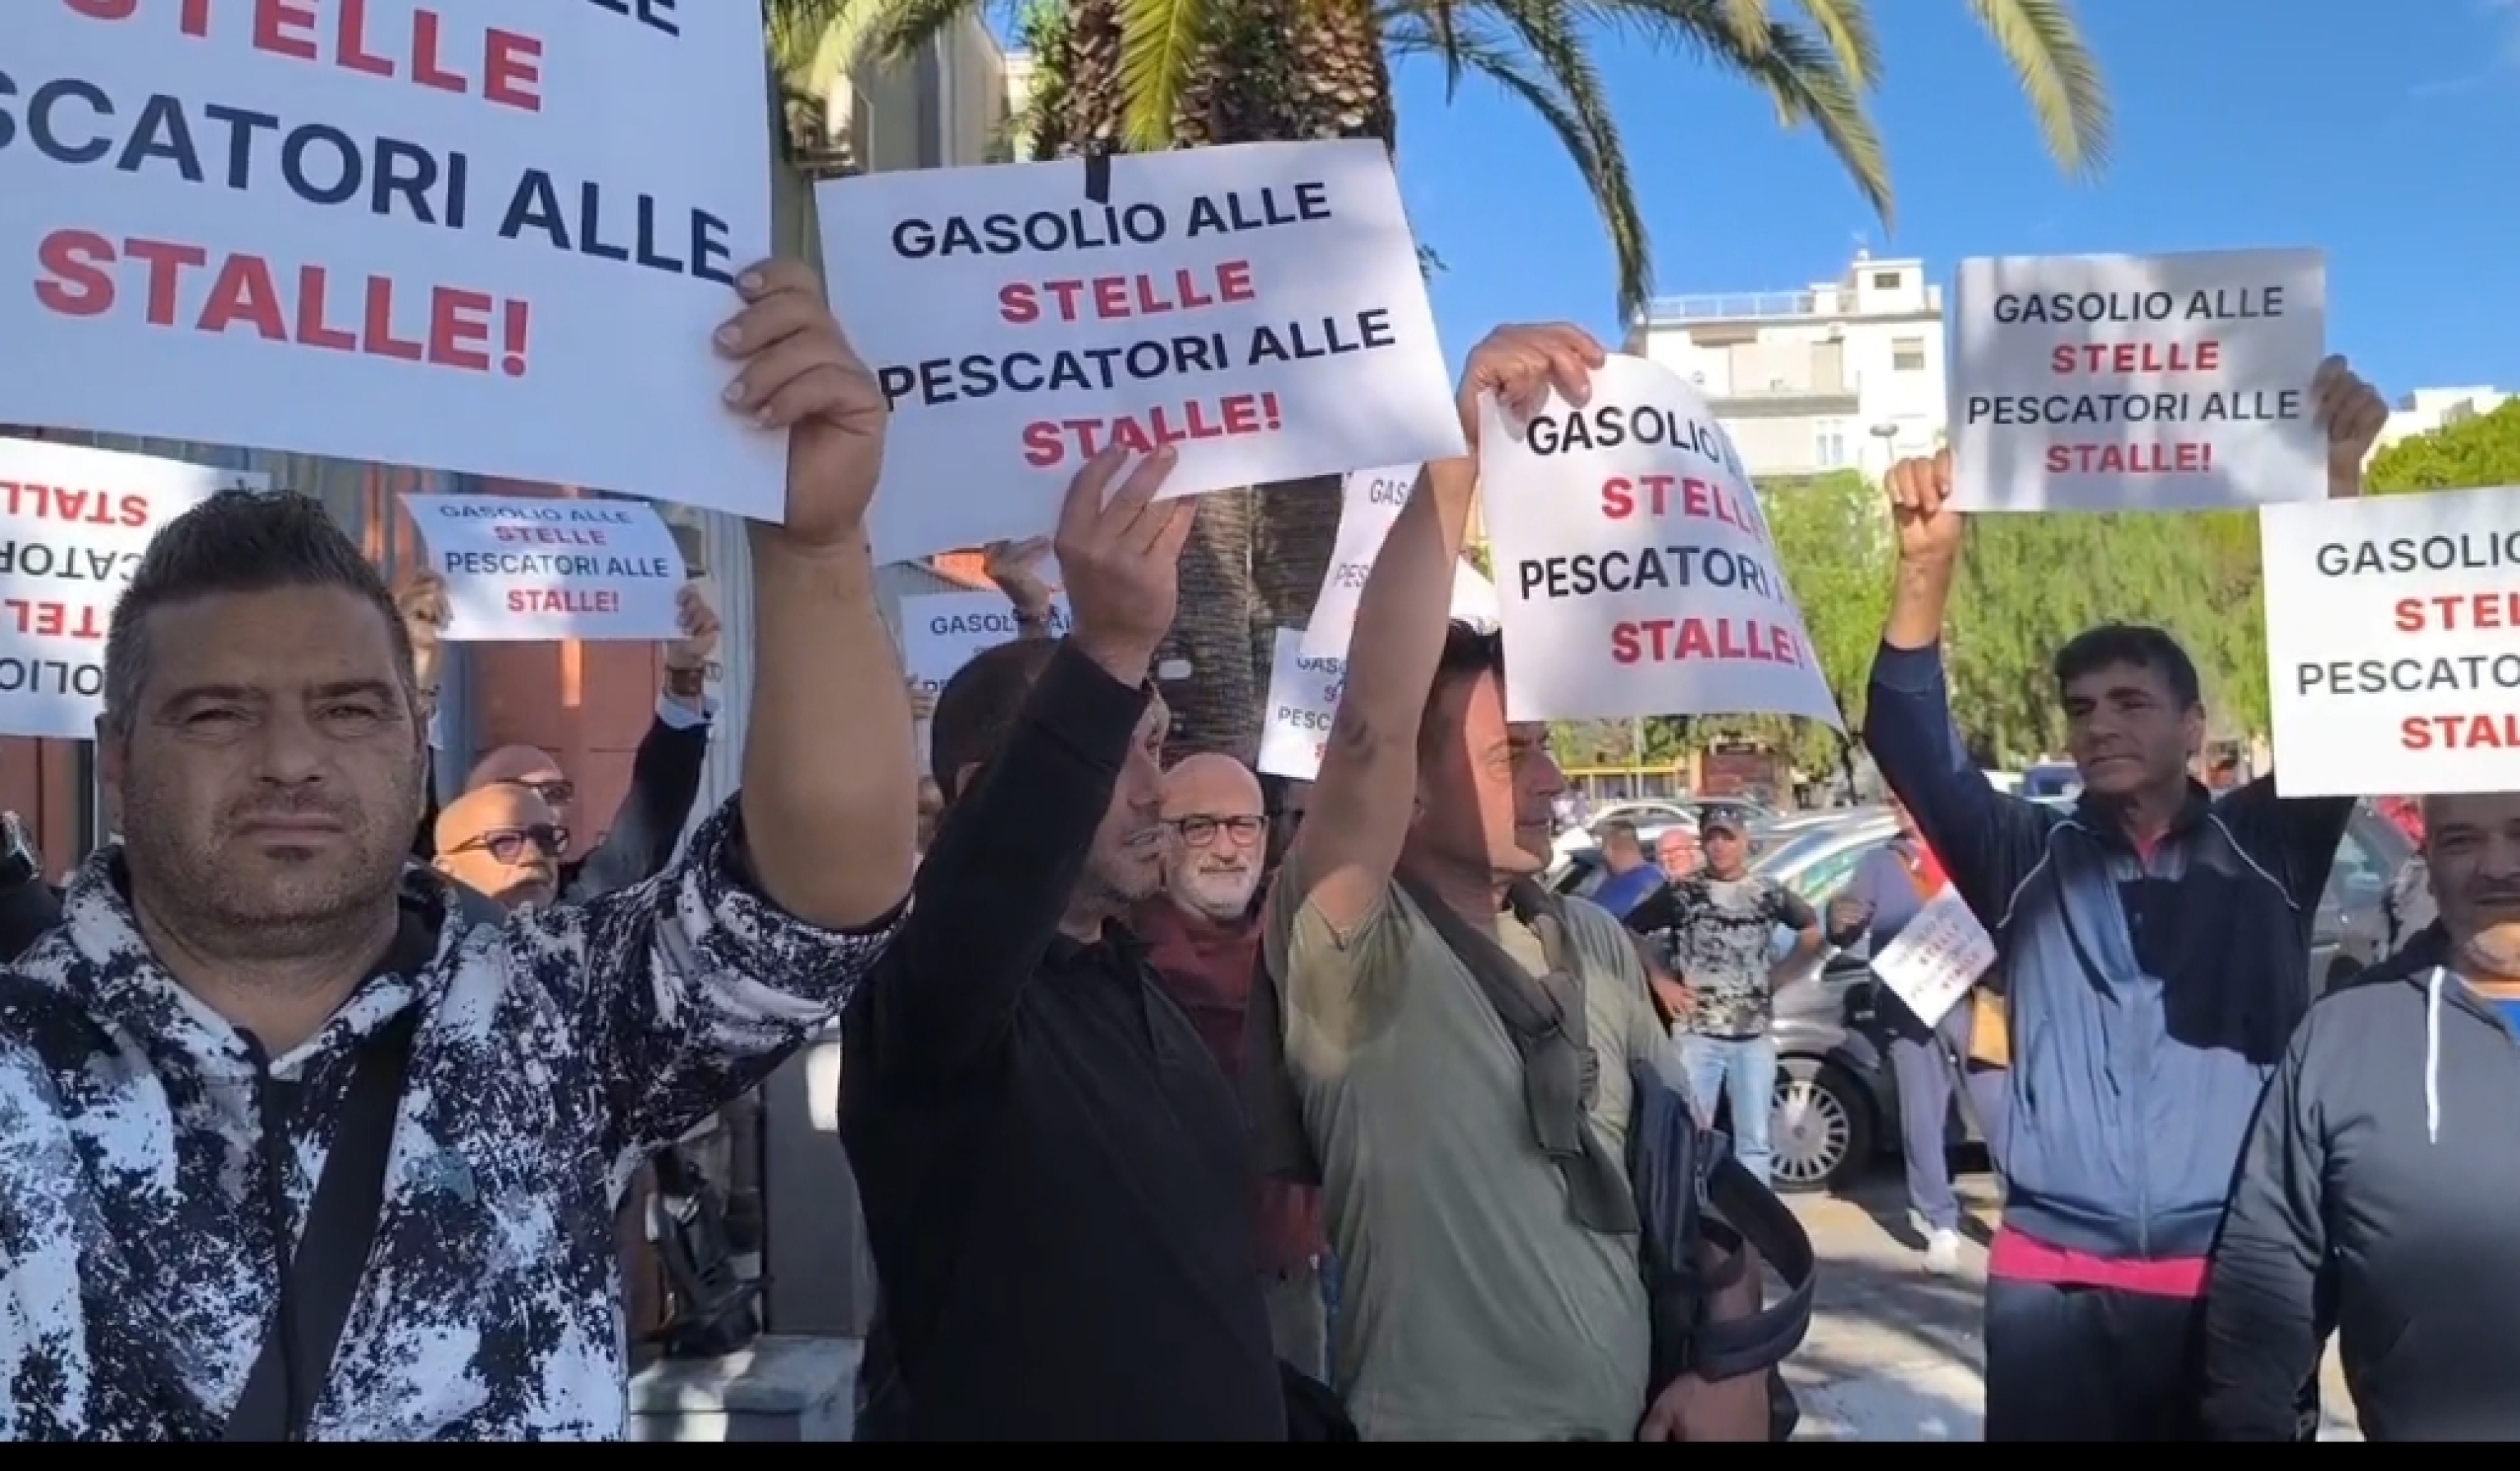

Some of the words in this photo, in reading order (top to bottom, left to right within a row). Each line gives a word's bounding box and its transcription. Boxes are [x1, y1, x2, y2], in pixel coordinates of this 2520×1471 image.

[62, 0, 542, 112] ELLE
[0, 70, 466, 229] CATORI
[499, 168, 735, 286] ALLE
[892, 203, 1166, 258] GASOLIO
[1186, 182, 1331, 237] ALLE
[34, 229, 530, 377] STALLE!
[998, 260, 1256, 324] STELLE
[1994, 291, 2173, 322] GASOLIO
[2185, 286, 2284, 320] ALLE
[879, 332, 1228, 413] PESCATORI
[1249, 308, 1396, 367] ALLE
[2051, 340, 2220, 373] STELLE
[1968, 394, 2188, 424] PESCATORI
[2198, 390, 2301, 421] ALLE
[1022, 392, 1281, 468] STALLE!
[1527, 406, 1720, 464] GASOLIO
[2045, 443, 2212, 473] STALLE!
[1369, 477, 1408, 504] GAS
[494, 526, 606, 546] STELLE
[445, 550, 600, 575] PESCATORI
[606, 557, 670, 578] ALLE
[1520, 547, 1770, 600] PESCATORI
[4, 599, 103, 638] TEL
[506, 588, 619, 613] STALLE!
[929, 614, 1016, 635] GASOL
[1611, 618, 1805, 670] STALLE!
[0, 657, 104, 695] OLIO
[1278, 706, 1331, 730] PESC
